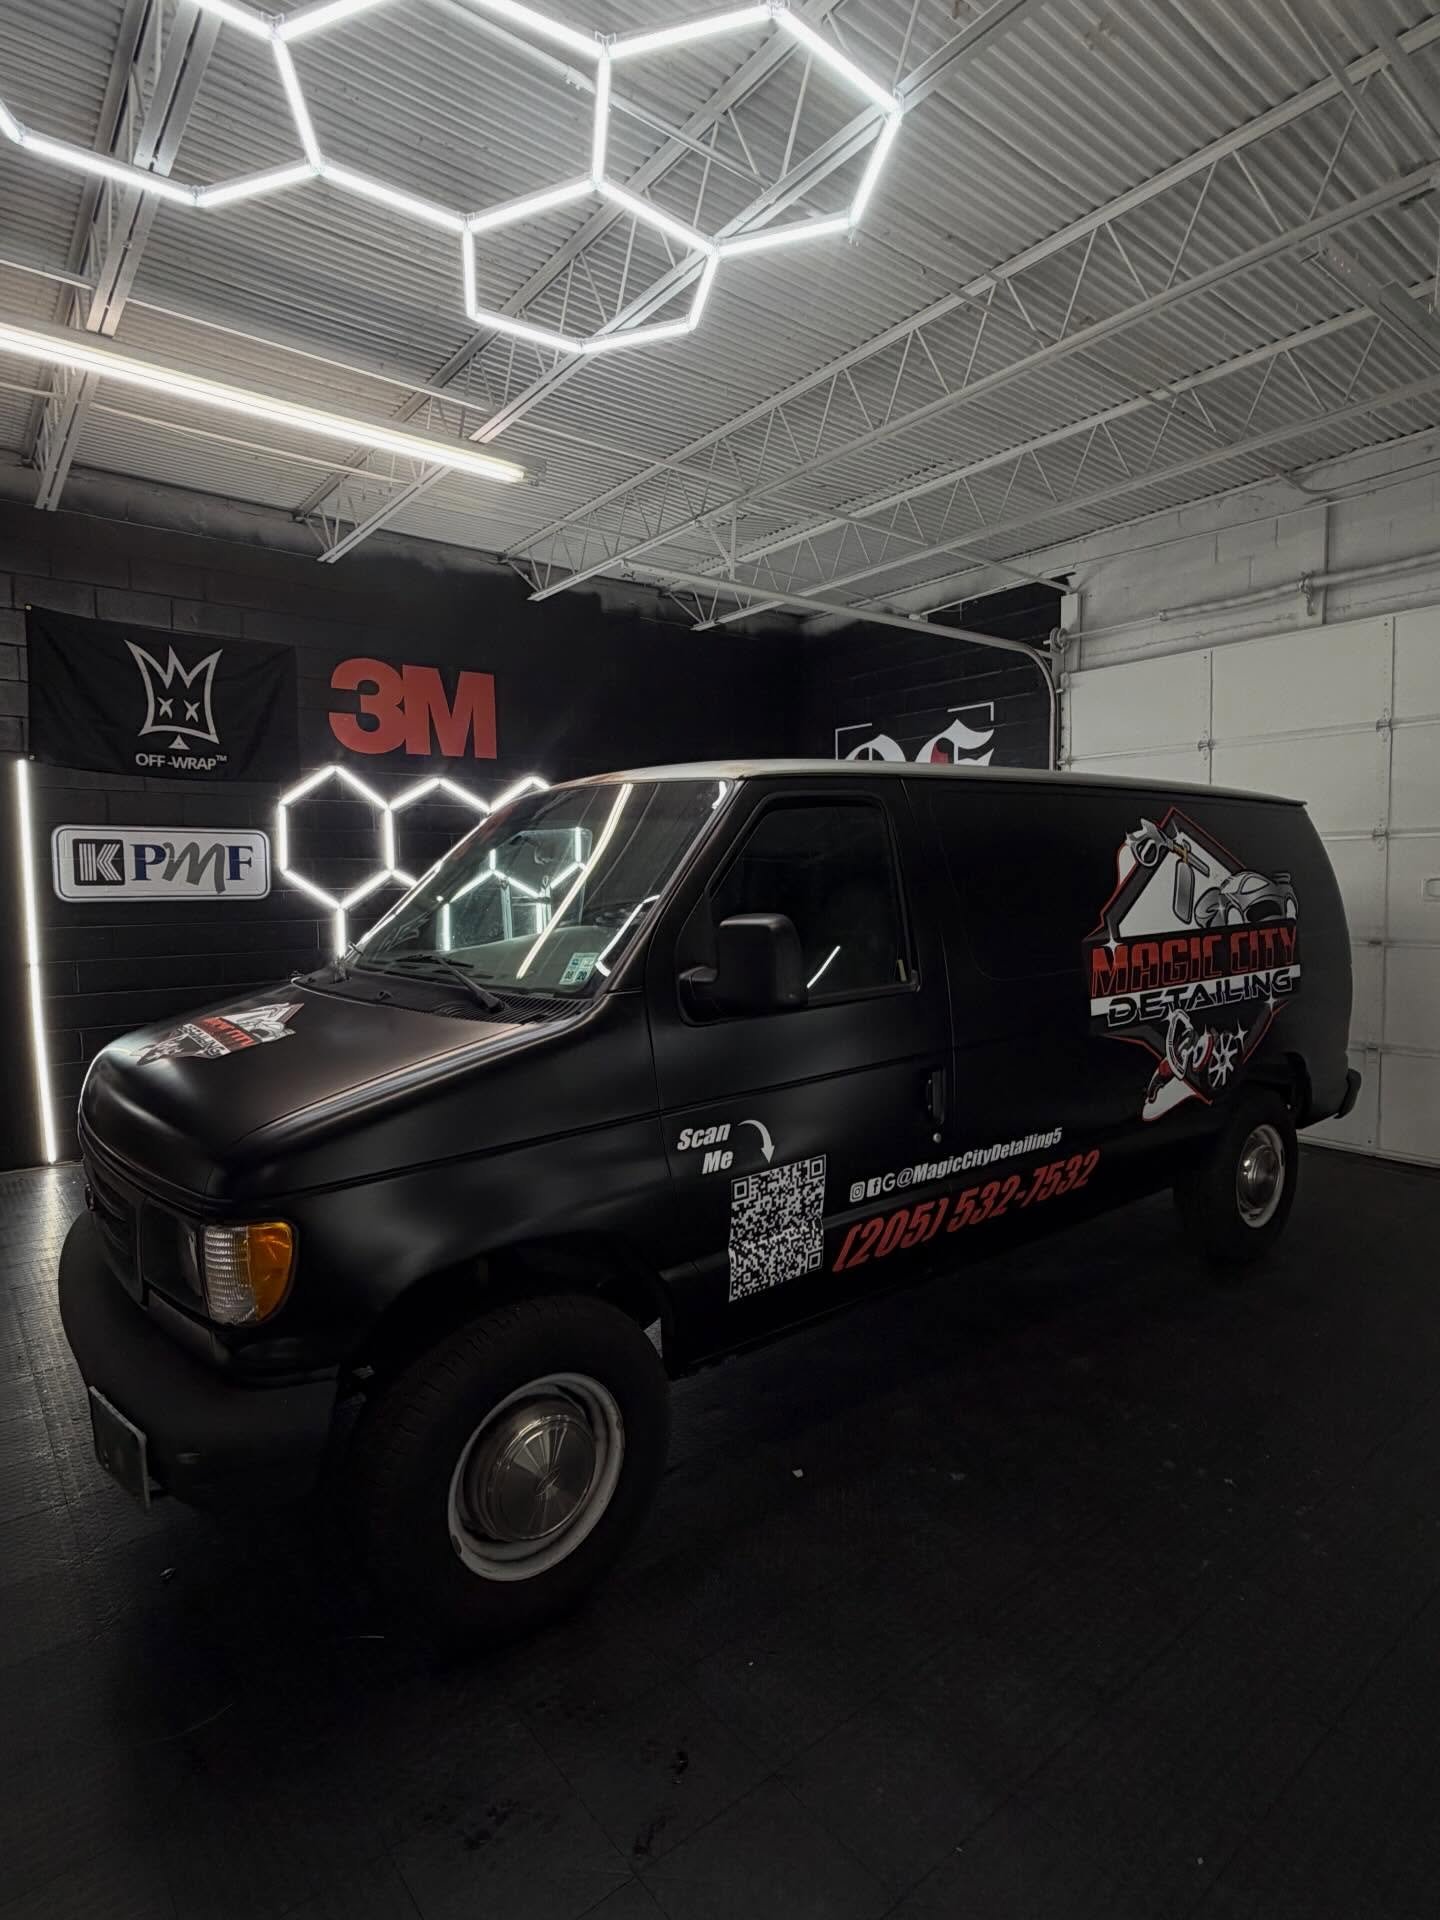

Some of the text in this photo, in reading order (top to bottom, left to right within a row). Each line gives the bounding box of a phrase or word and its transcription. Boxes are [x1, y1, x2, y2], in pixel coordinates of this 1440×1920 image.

[328, 657, 497, 760] 3M
[1091, 928, 1297, 997] MAGIC CITY
[1107, 969, 1293, 1027] DETAILING
[677, 1122, 731, 1151] Scan
[701, 1149, 734, 1175] Me
[832, 1149, 1100, 1273] (205) 532-7532
